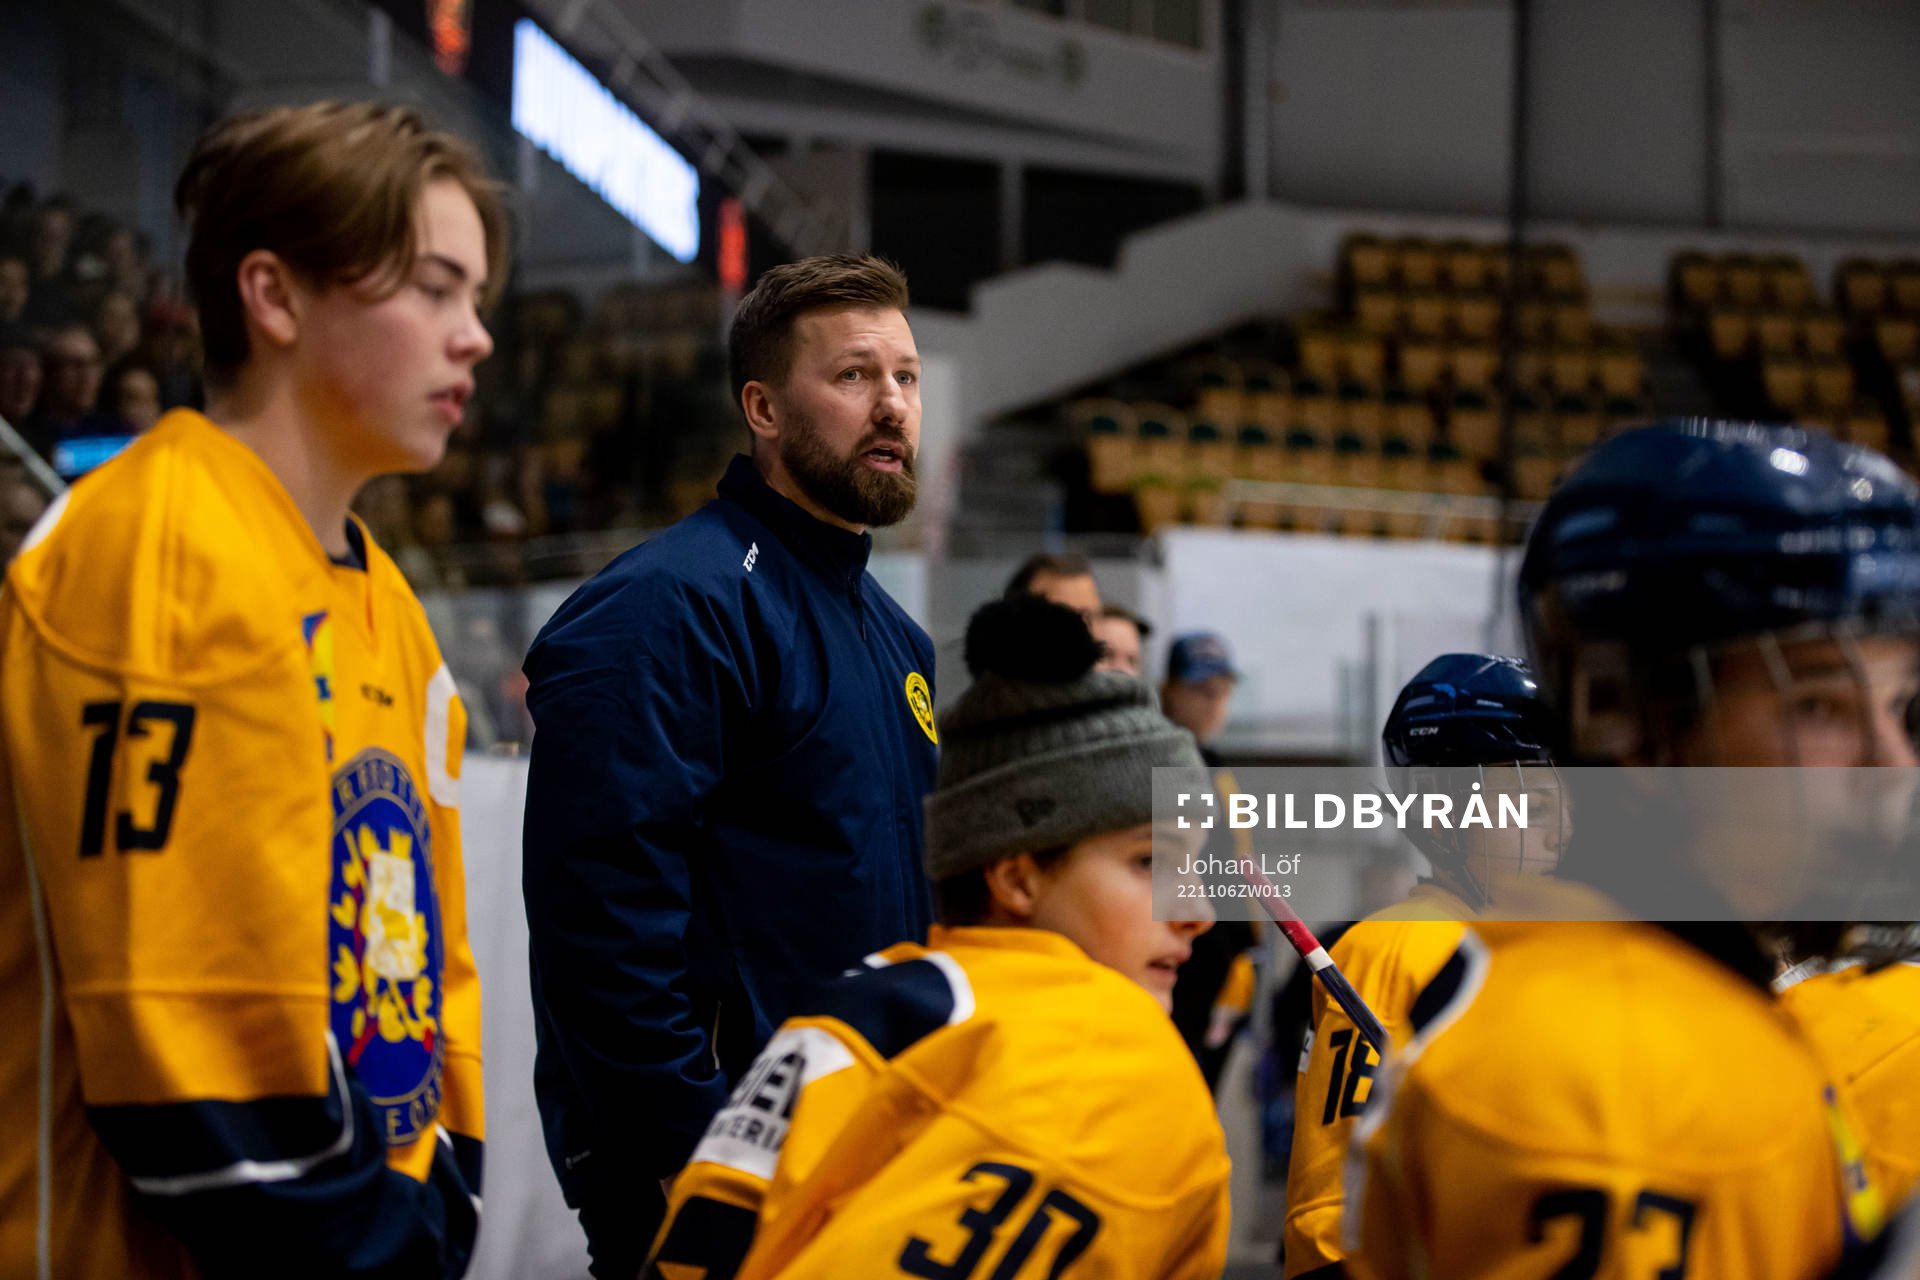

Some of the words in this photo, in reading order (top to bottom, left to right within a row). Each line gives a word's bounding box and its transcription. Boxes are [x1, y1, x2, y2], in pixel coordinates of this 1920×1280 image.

[742, 541, 759, 573] CCM
[80, 702, 195, 858] 13
[1409, 727, 1439, 736] CCM
[1321, 1028, 1380, 1126] 18
[898, 1162, 1103, 1280] 30
